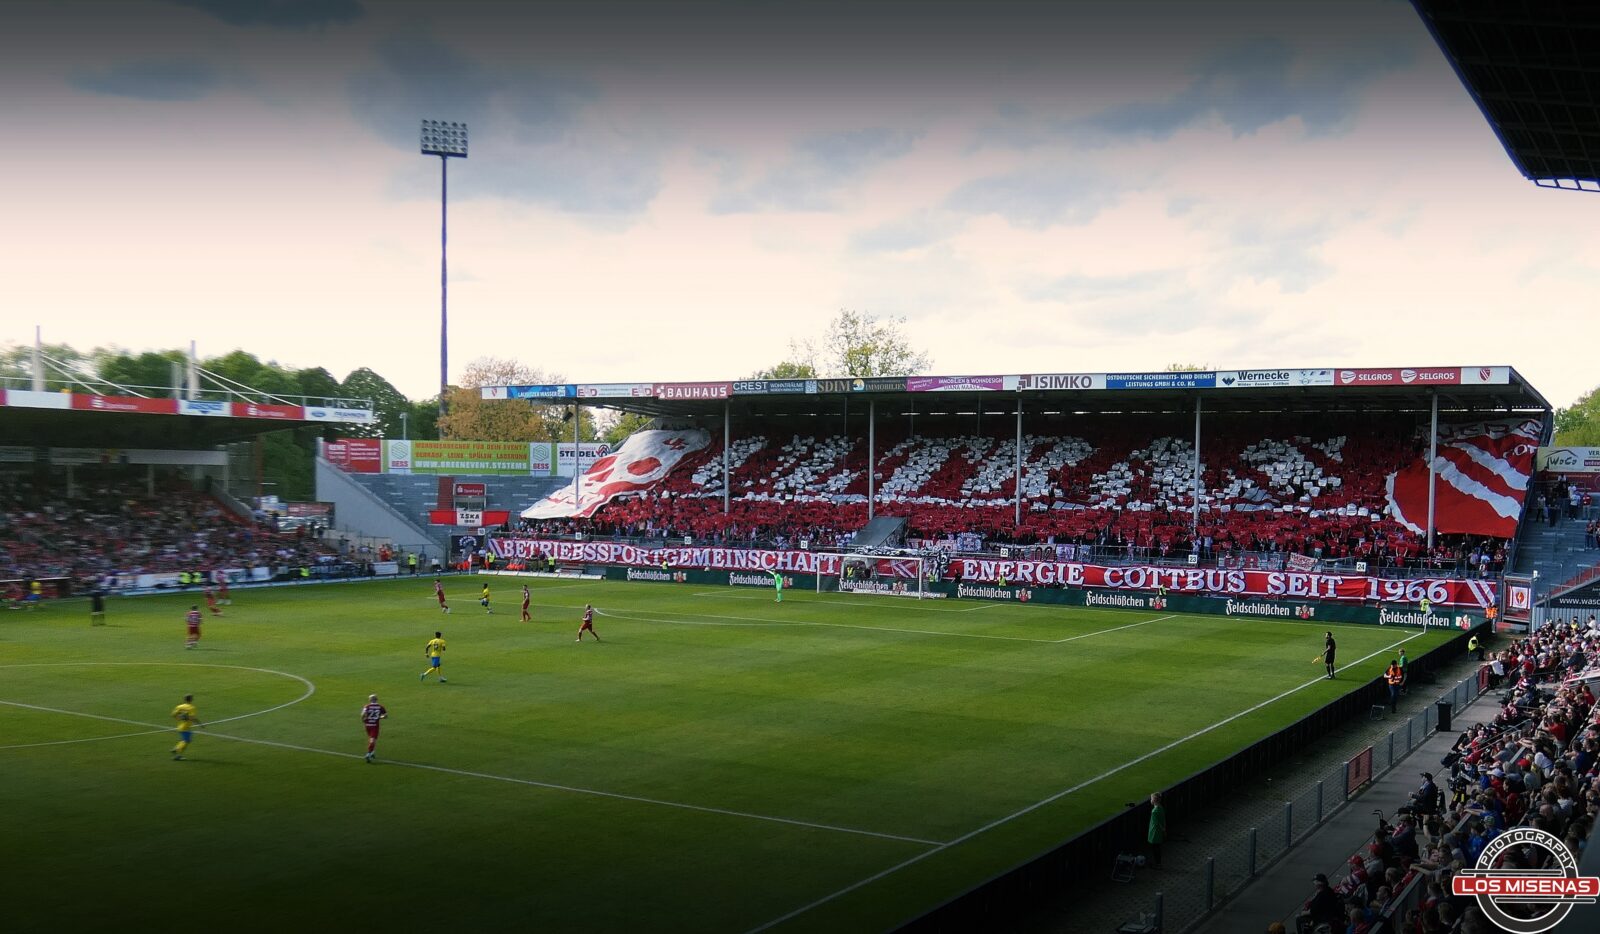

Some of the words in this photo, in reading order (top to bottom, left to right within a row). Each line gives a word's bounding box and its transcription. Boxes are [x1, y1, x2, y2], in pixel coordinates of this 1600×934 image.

[1238, 370, 1290, 380] Wernecke
[1358, 373, 1393, 381] SELGROS
[1419, 372, 1454, 380] SELGROS
[732, 381, 769, 390] CREST
[817, 381, 850, 392] SDIM
[865, 383, 906, 391] IMMOBILIEN
[1035, 375, 1093, 388] ISIMKO
[667, 386, 727, 398] BAUHAUS
[1550, 456, 1577, 466] WoCo
[502, 539, 840, 575] BETRIEBSSPORTGEMEINSCHAFT
[961, 559, 1085, 585] ENERGIE
[1103, 566, 1246, 593] COTTBUS
[1266, 572, 1344, 599] SEIT
[1366, 578, 1449, 604] 1966
[627, 567, 671, 581] Feldschlößchen
[729, 570, 775, 586] Feldschlößchen
[957, 583, 1011, 599] Feldschlößchen
[1085, 590, 1145, 608] Feldschlößchen
[1226, 598, 1290, 616] Feldschlößchen
[1379, 608, 1450, 627] Feldschlößchen
